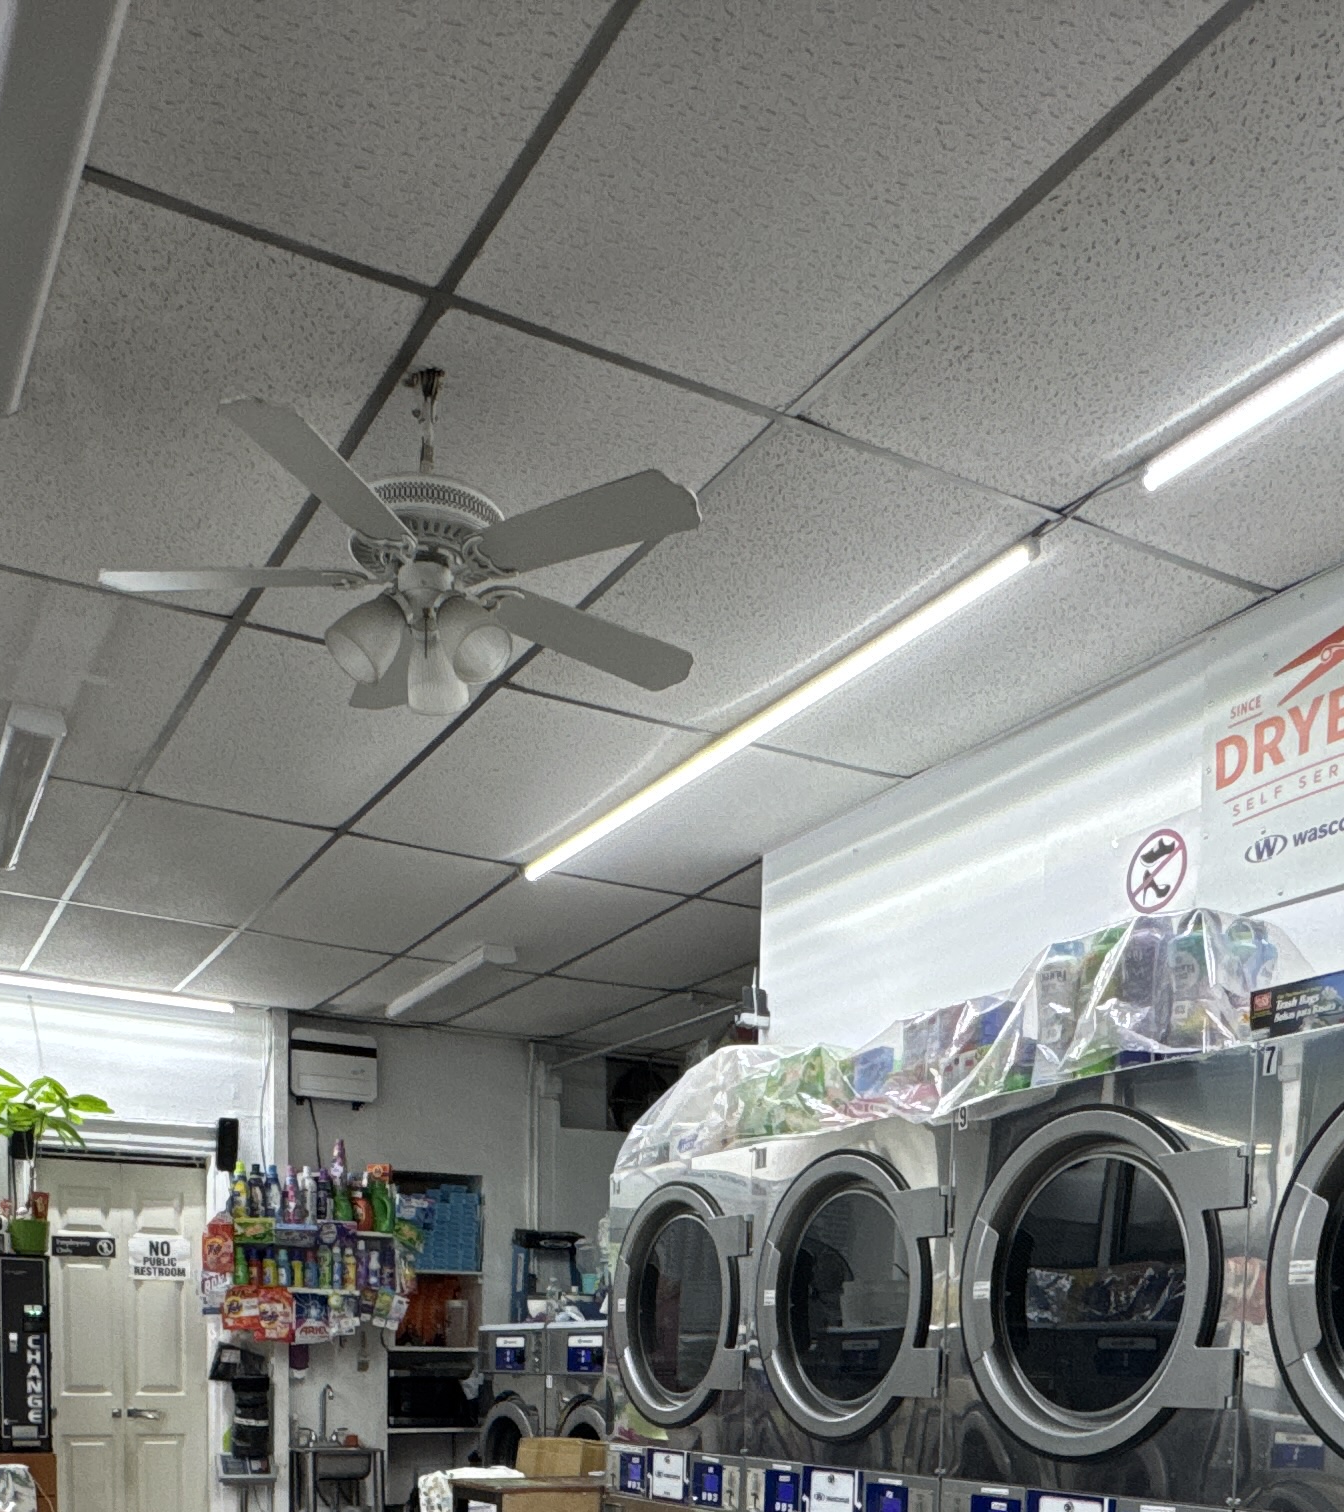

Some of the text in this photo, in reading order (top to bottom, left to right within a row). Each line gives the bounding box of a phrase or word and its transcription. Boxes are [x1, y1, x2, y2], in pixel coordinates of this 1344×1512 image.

[1230, 695, 1261, 719] SINCE
[1233, 785, 1283, 817] SELF
[1265, 1046, 1276, 1073] 7
[960, 1107, 966, 1127] 9
[149, 1241, 171, 1256] NO
[134, 1267, 186, 1277] RESTROOM
[143, 1257, 177, 1266] PUBLIC
[26, 1335, 43, 1423] CHANGE
